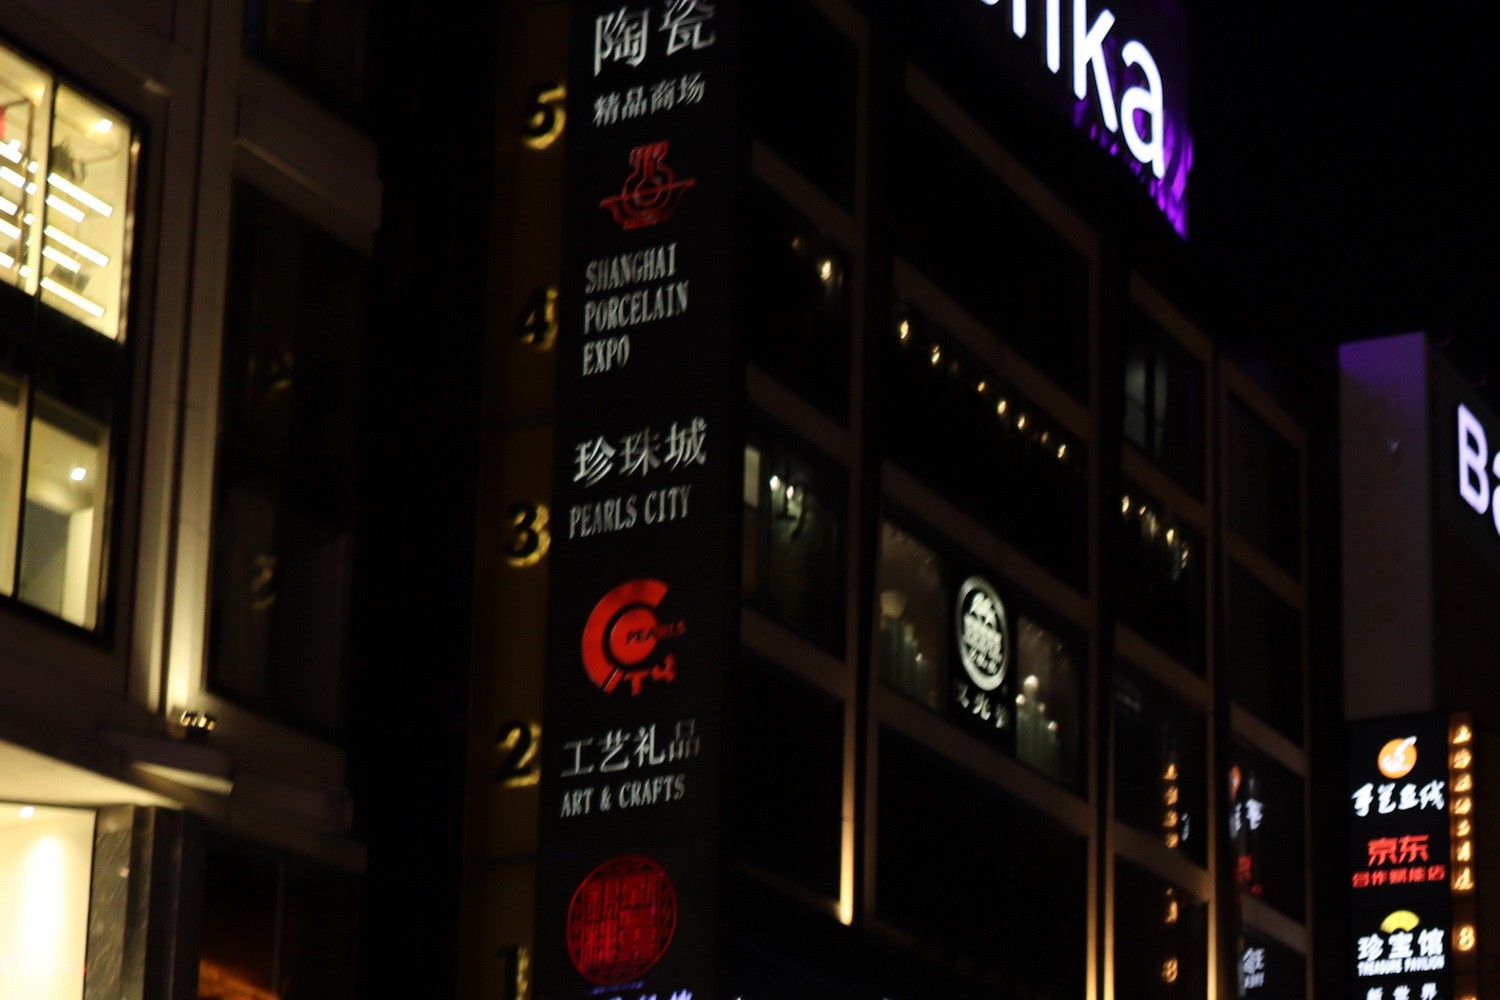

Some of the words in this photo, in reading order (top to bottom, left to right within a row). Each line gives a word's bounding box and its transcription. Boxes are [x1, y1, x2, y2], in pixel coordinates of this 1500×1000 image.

[522, 83, 567, 150] 5
[585, 243, 677, 296] SHANGHAI
[513, 287, 558, 352] 4
[583, 280, 690, 336] PORCELAIN
[582, 336, 631, 377] EXPO
[573, 416, 708, 488] 珍珠城
[503, 503, 551, 568] 3
[569, 495, 638, 540] PEARLS
[643, 484, 692, 525] CITY
[497, 719, 542, 788] 2
[560, 718, 700, 778] 工艺礼品
[560, 787, 595, 819] ART
[600, 788, 612, 812] &
[619, 773, 686, 809] CRAFTS
[1368, 834, 1430, 866] 京东
[1458, 925, 1475, 951] 8
